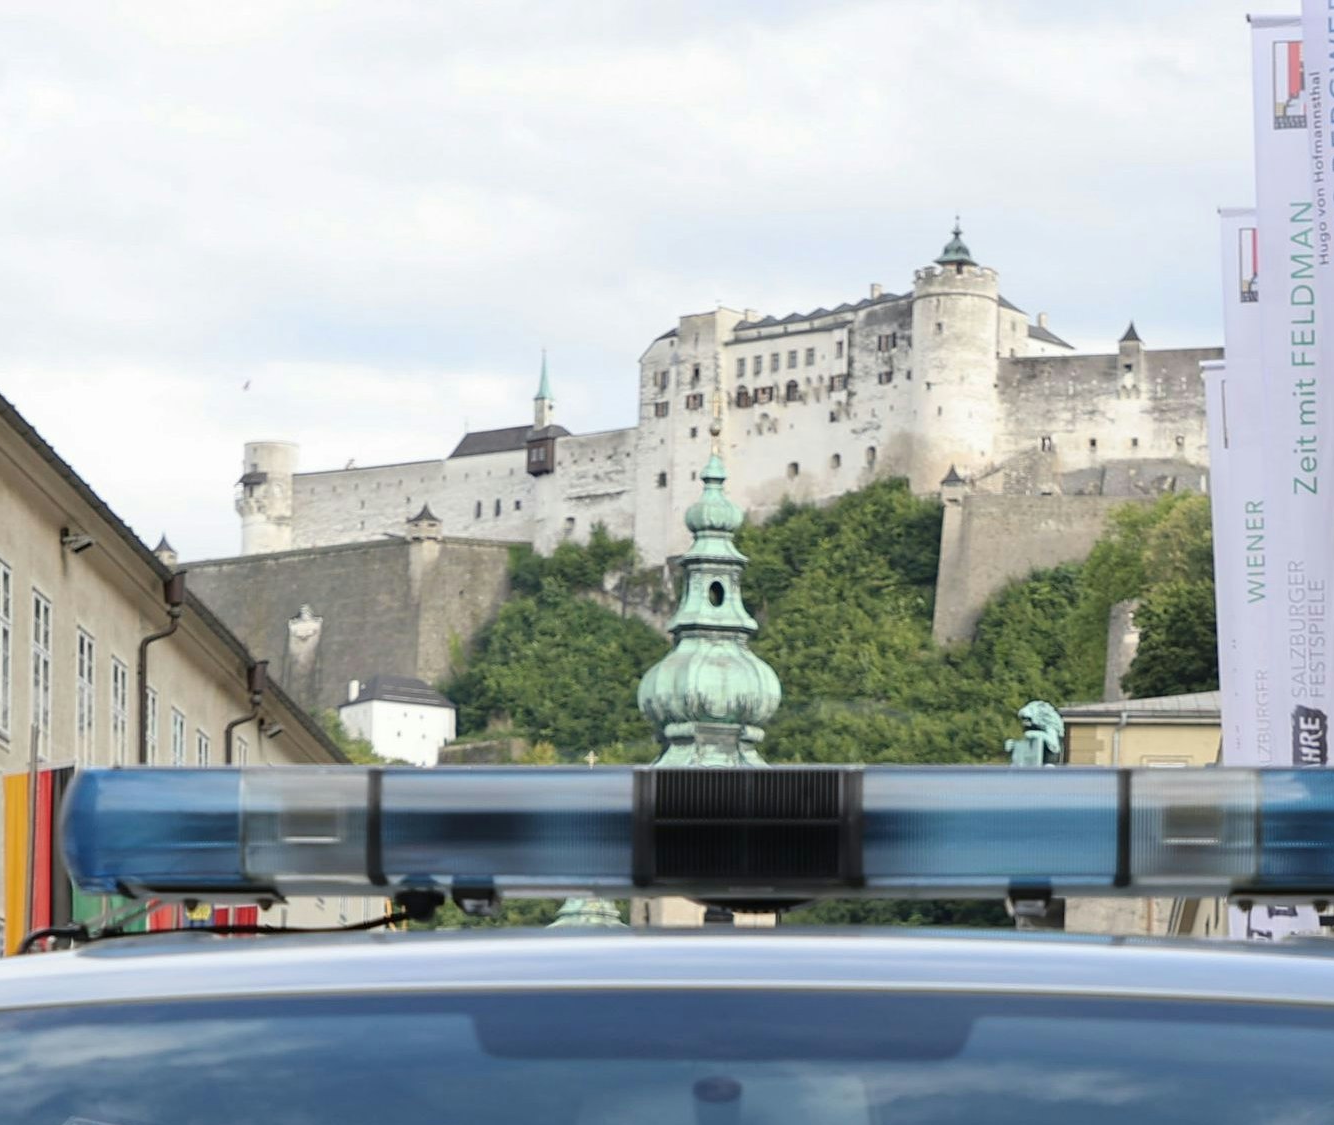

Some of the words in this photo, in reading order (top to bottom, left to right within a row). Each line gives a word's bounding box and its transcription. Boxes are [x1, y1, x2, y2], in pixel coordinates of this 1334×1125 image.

[1309, 71, 1325, 183] Hofmannsthal
[1316, 188, 1327, 217] von
[1290, 201, 1316, 367] FELDMAN
[1319, 222, 1331, 265] Hugo
[1291, 378, 1317, 426] mit
[1293, 434, 1318, 494] Zeit
[1245, 500, 1267, 603] WIENER
[1288, 559, 1308, 699] SALZBURGER
[1308, 579, 1326, 698] FESTSPIELE
[1299, 714, 1323, 766] HRE
